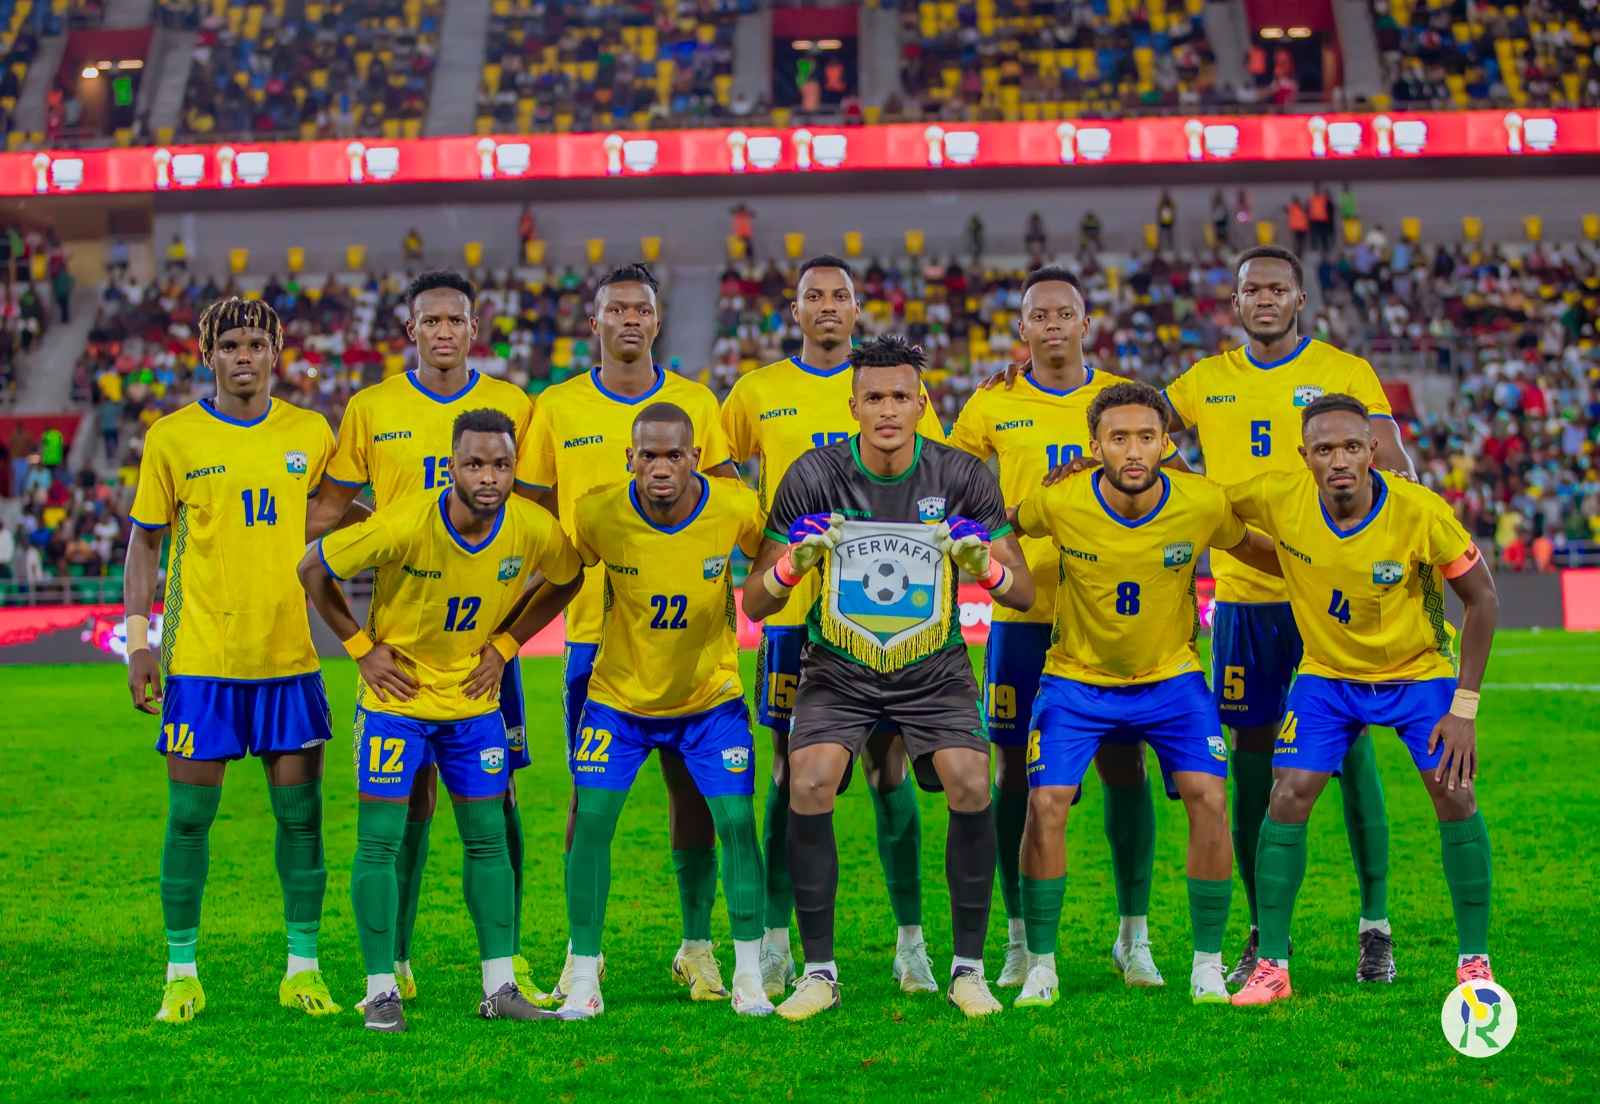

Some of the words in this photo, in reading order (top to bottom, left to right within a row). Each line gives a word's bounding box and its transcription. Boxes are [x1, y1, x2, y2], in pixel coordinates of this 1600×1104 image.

[1251, 420, 1271, 457] 5
[241, 488, 277, 527] 14
[847, 539, 931, 563] FERWAFA
[444, 597, 482, 632] 12
[650, 595, 688, 629] 22
[1116, 582, 1140, 615] 8
[1328, 589, 1350, 624] 4
[768, 672, 797, 708] 15
[989, 682, 1016, 719] 19
[1224, 666, 1245, 700] 5
[164, 723, 194, 758] 14
[576, 727, 612, 763] 22
[1279, 711, 1298, 744] 4
[369, 736, 406, 773] 12
